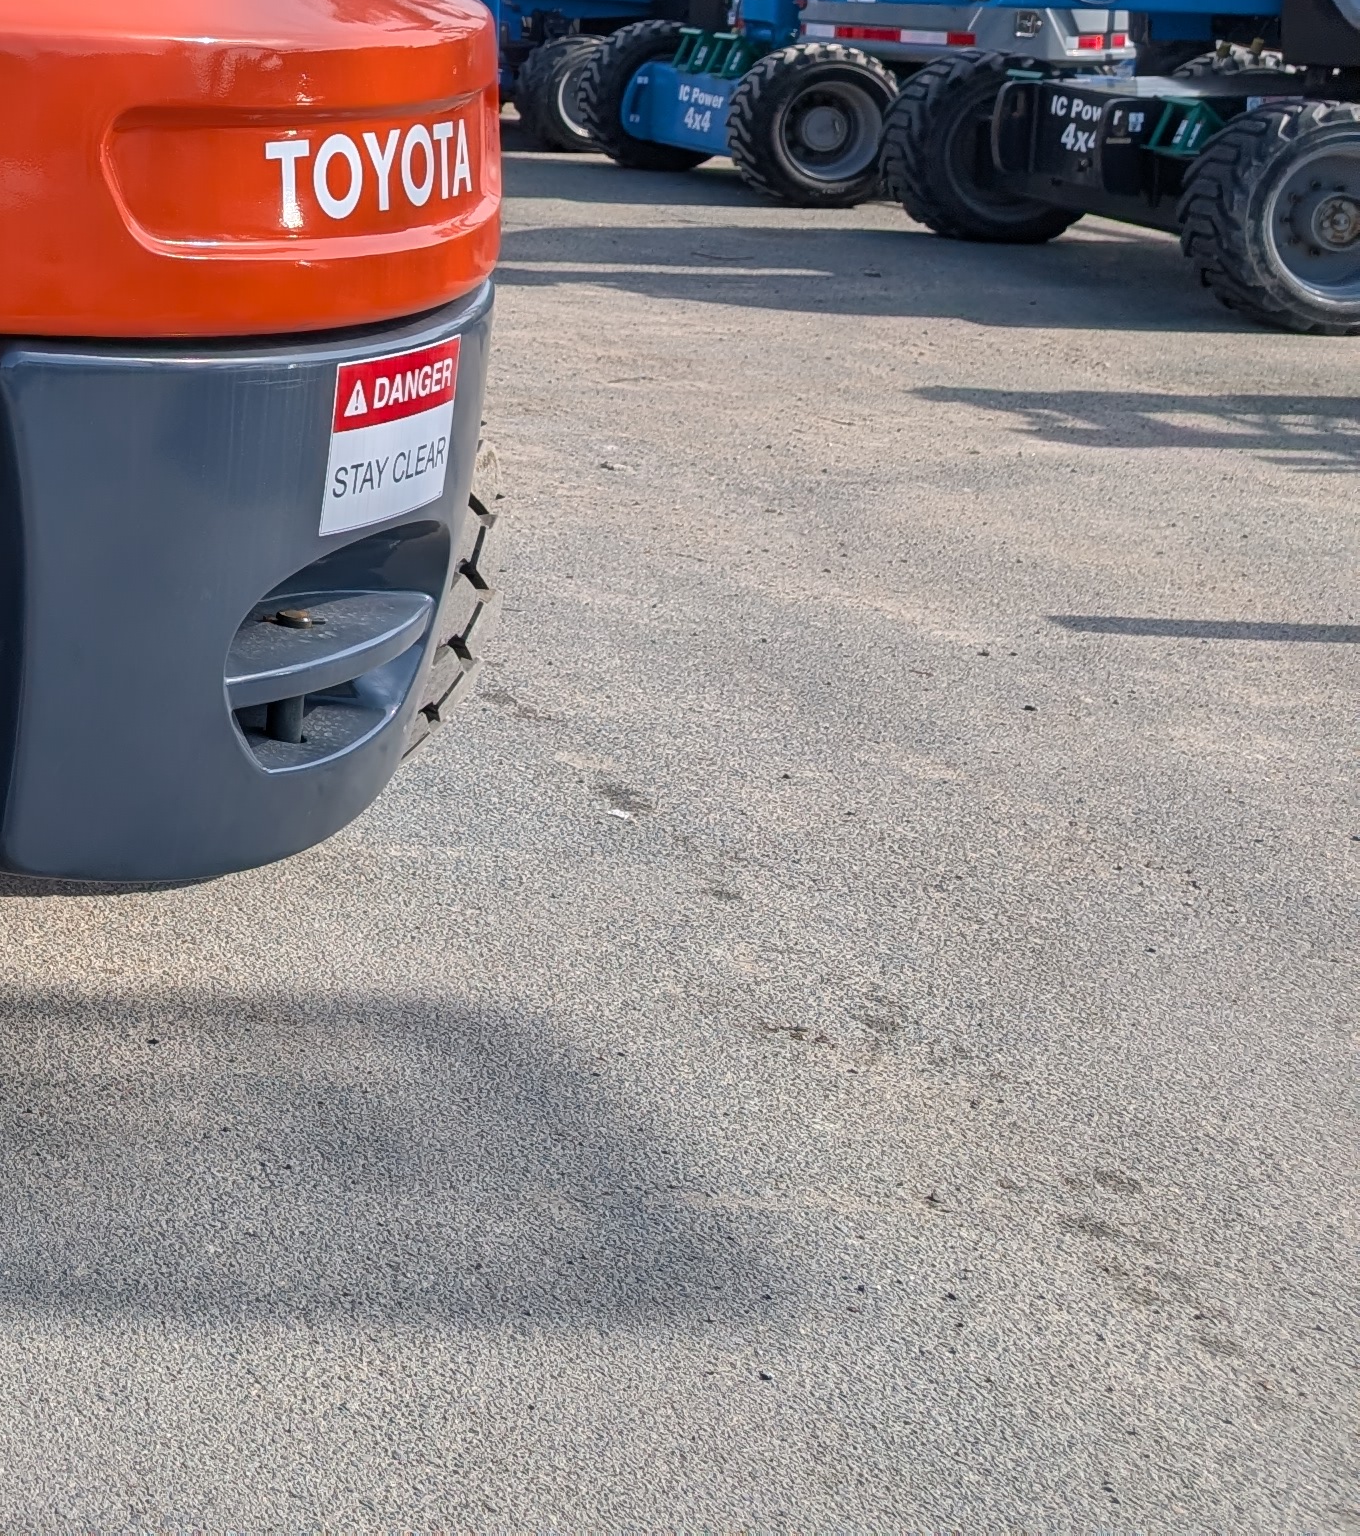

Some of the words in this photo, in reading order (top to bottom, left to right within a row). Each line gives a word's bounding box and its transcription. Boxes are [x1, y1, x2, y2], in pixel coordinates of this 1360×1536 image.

[678, 84, 691, 102] IC
[691, 87, 724, 109] Power
[1051, 95, 1068, 116] IC
[1071, 98, 1123, 125] Powr
[684, 107, 712, 133] 4x4
[265, 118, 473, 229] TOYOTA
[373, 357, 452, 410] DANGER
[332, 456, 390, 499] STAY
[392, 435, 447, 485] CLEAR
